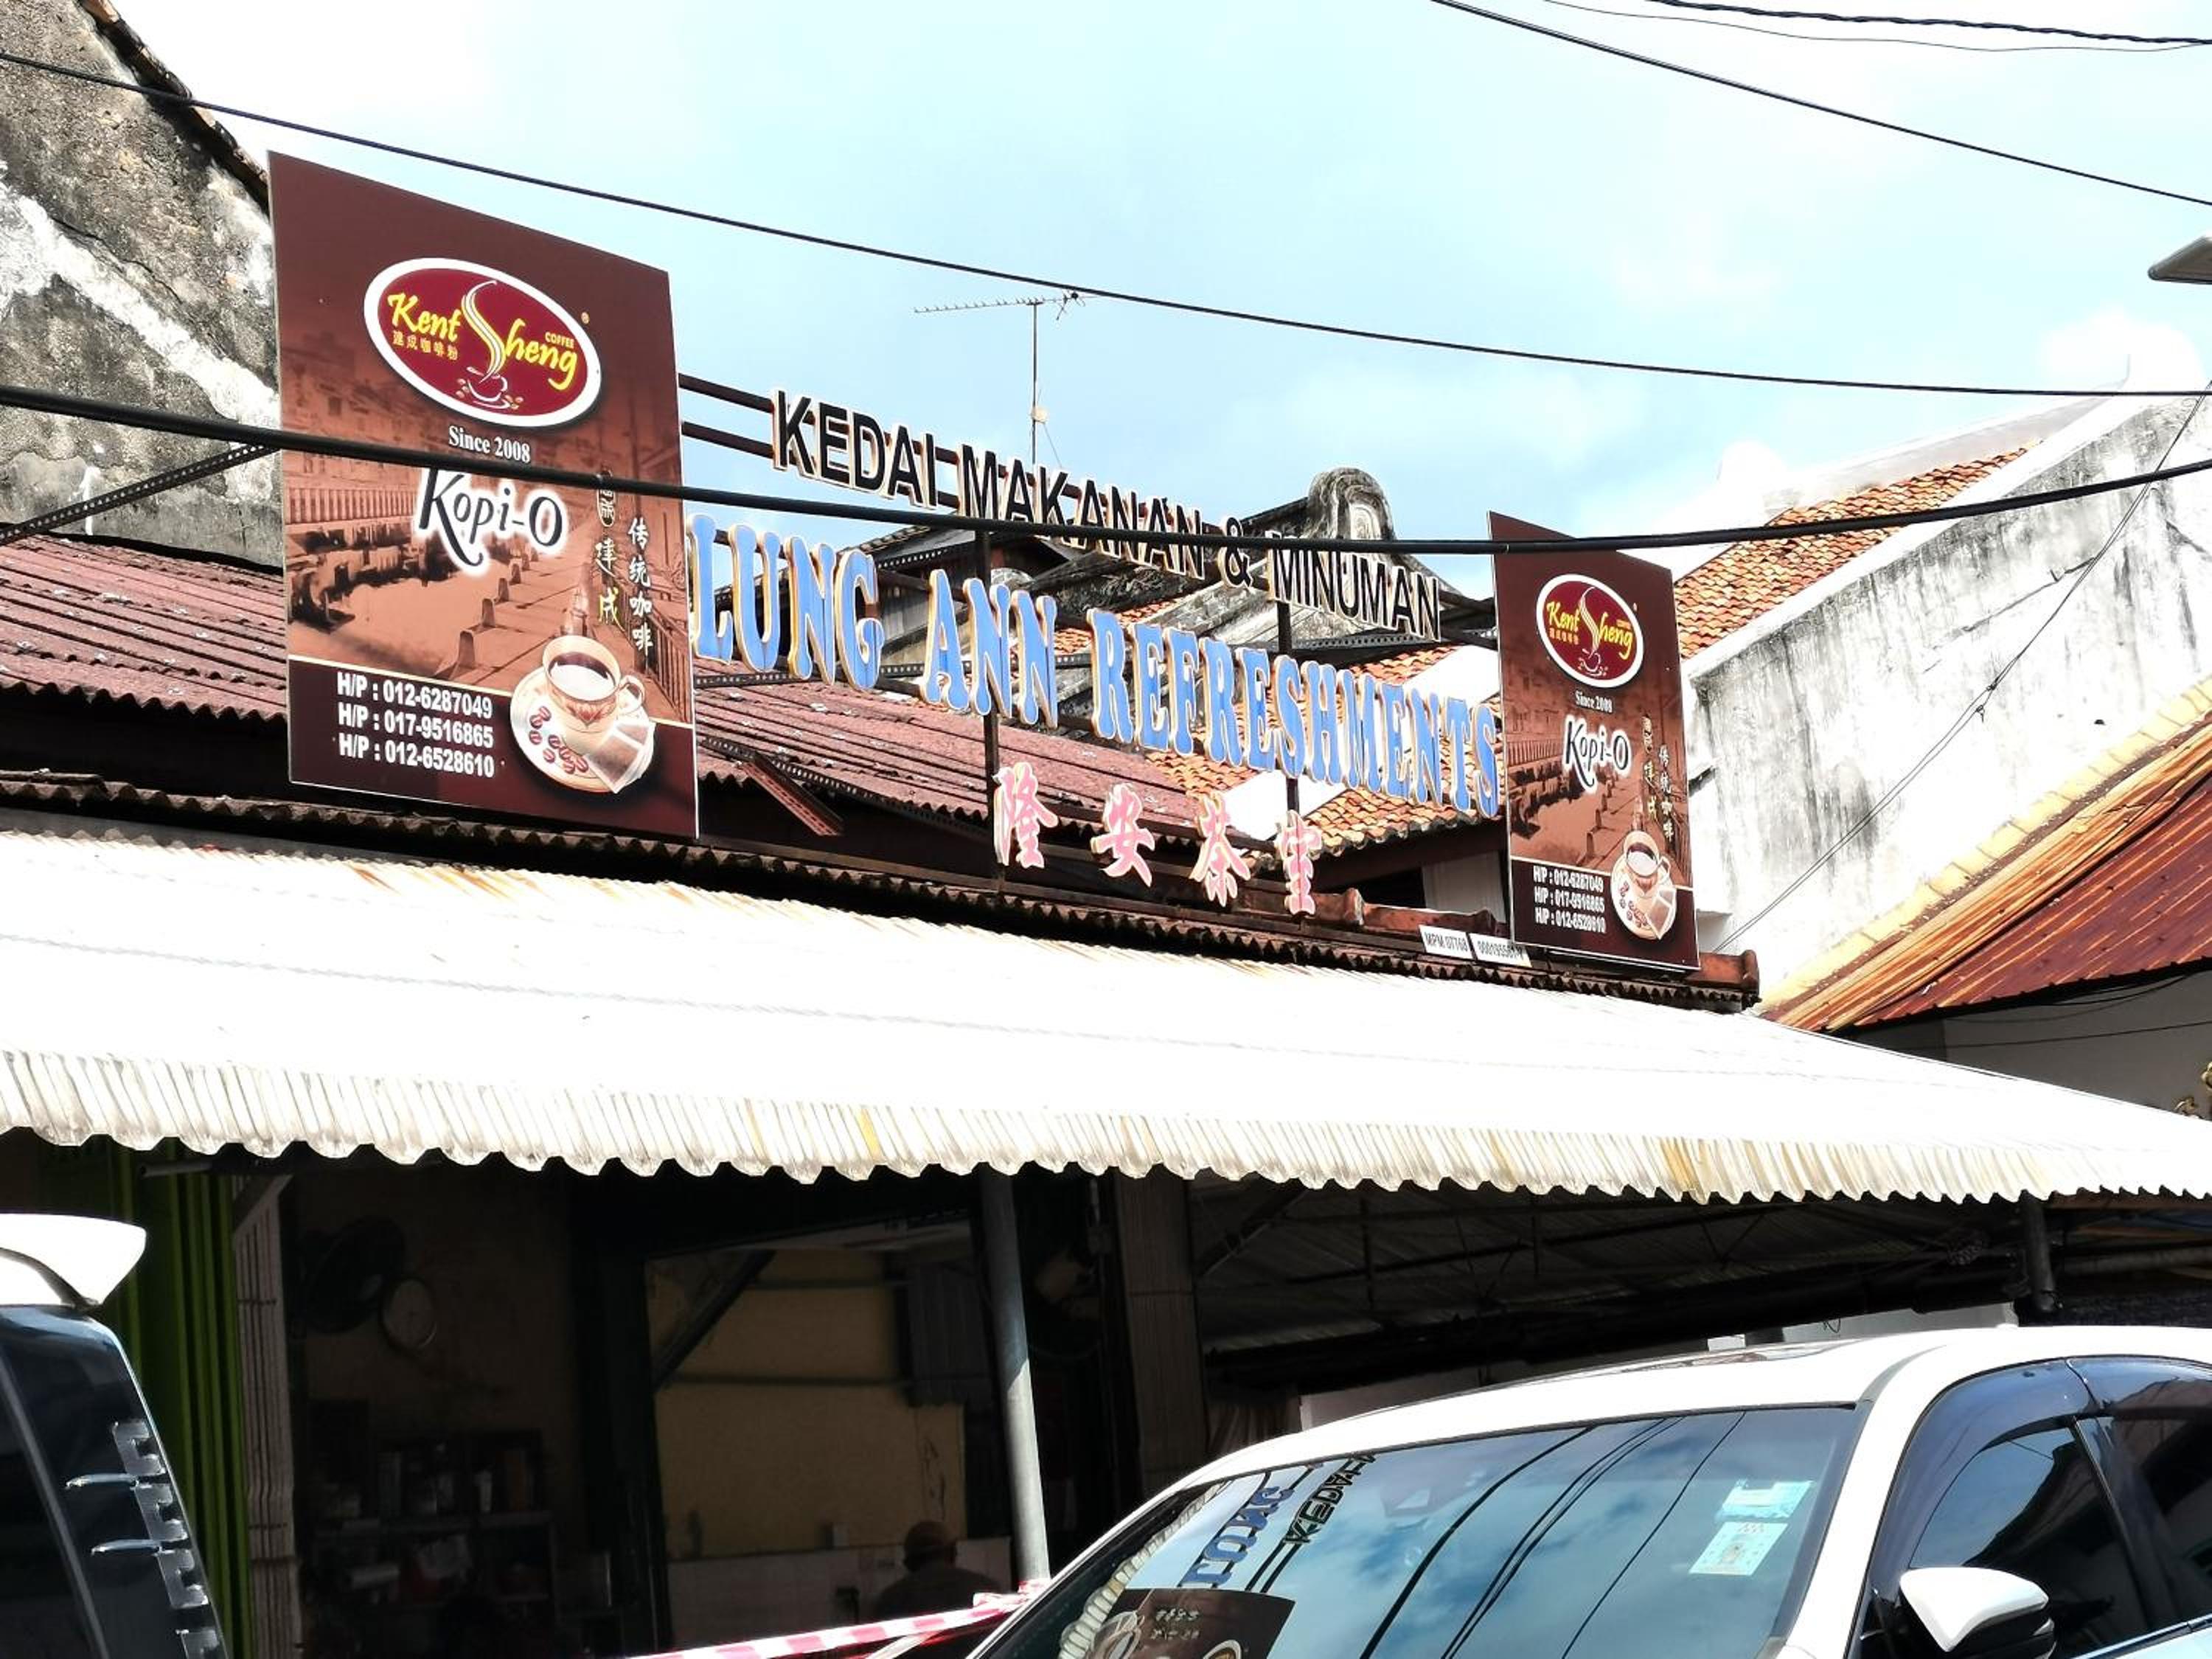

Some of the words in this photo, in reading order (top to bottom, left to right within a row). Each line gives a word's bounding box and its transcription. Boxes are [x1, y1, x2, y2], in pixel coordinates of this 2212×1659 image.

[388, 293, 462, 342] Kent
[545, 331, 575, 349] COFFEE
[448, 425, 491, 454] Since
[494, 436, 531, 463] 2008
[418, 467, 563, 567] Kopi-O
[773, 389, 939, 509] KEDAI
[959, 443, 1205, 580] MAKANAN
[1217, 516, 1253, 588] &
[1265, 530, 1441, 642] MINUMAN
[1546, 601, 1580, 632] Kent
[686, 515, 883, 691] LUNG
[920, 568, 1057, 730] ANN
[1087, 607, 1500, 817] REFRESHMENTS
[337, 671, 367, 698] H/P
[383, 679, 493, 719] 012-6287049
[338, 701, 369, 728] H/P
[384, 709, 494, 748] 017-9516865
[338, 732, 369, 759] H/P
[385, 740, 495, 778] 012-6528610
[1565, 720, 1630, 788] Kopi-O
